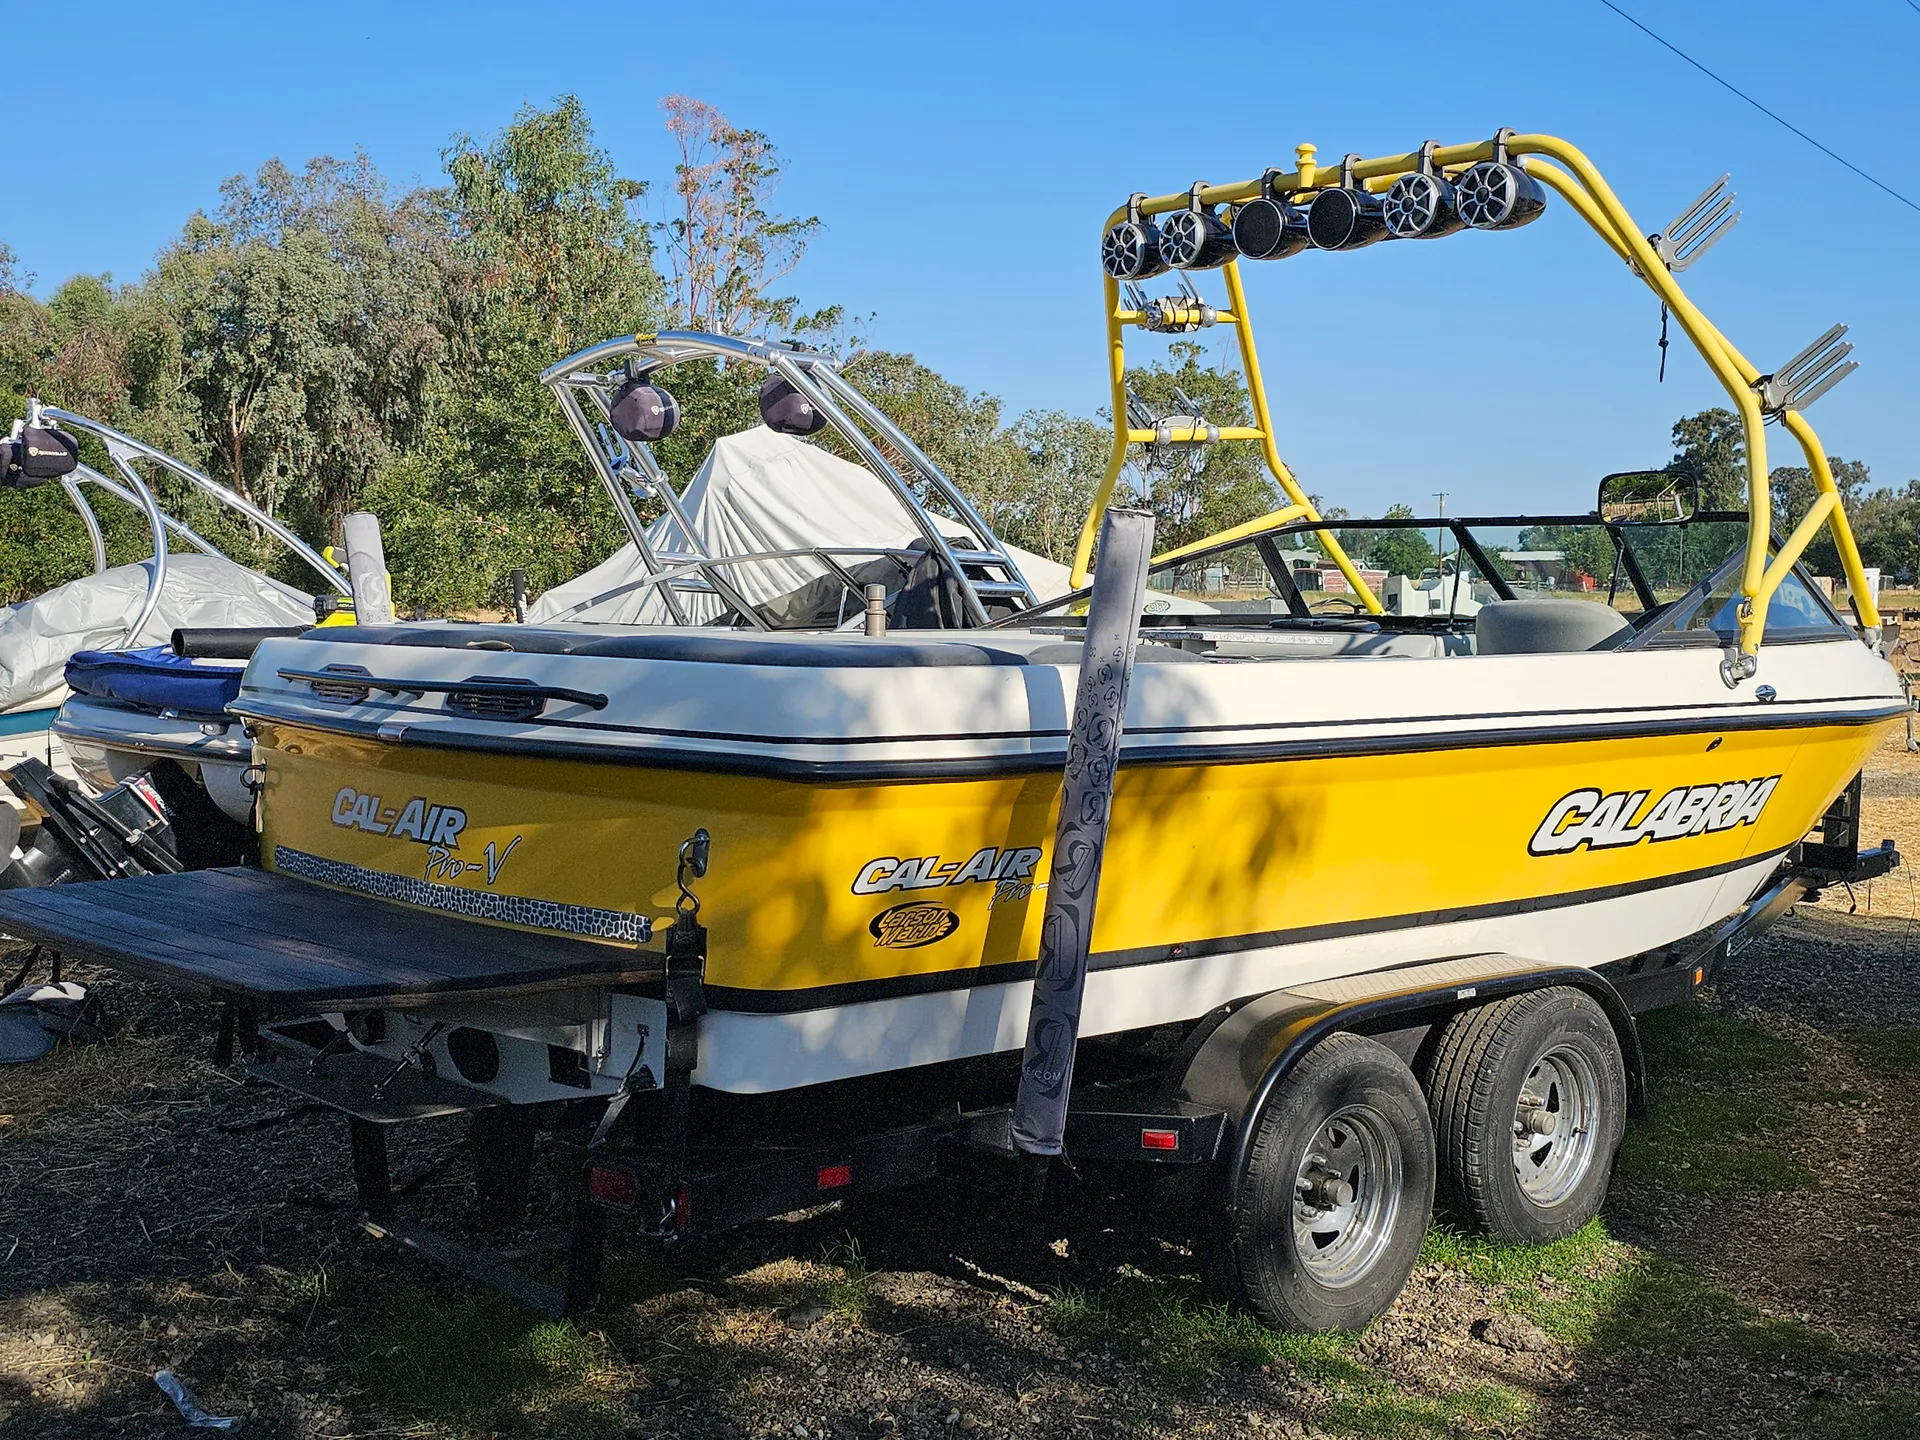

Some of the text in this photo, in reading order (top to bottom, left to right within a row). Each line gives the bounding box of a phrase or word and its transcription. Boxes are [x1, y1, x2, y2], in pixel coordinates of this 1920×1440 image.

[331, 786, 467, 849] CAL-AIR
[1527, 774, 1782, 857] CALABRIA
[424, 835, 522, 885] Pro-V
[851, 846, 1042, 895] CAL-AIR
[878, 908, 949, 928] Larson
[988, 879, 1049, 911] Pro-
